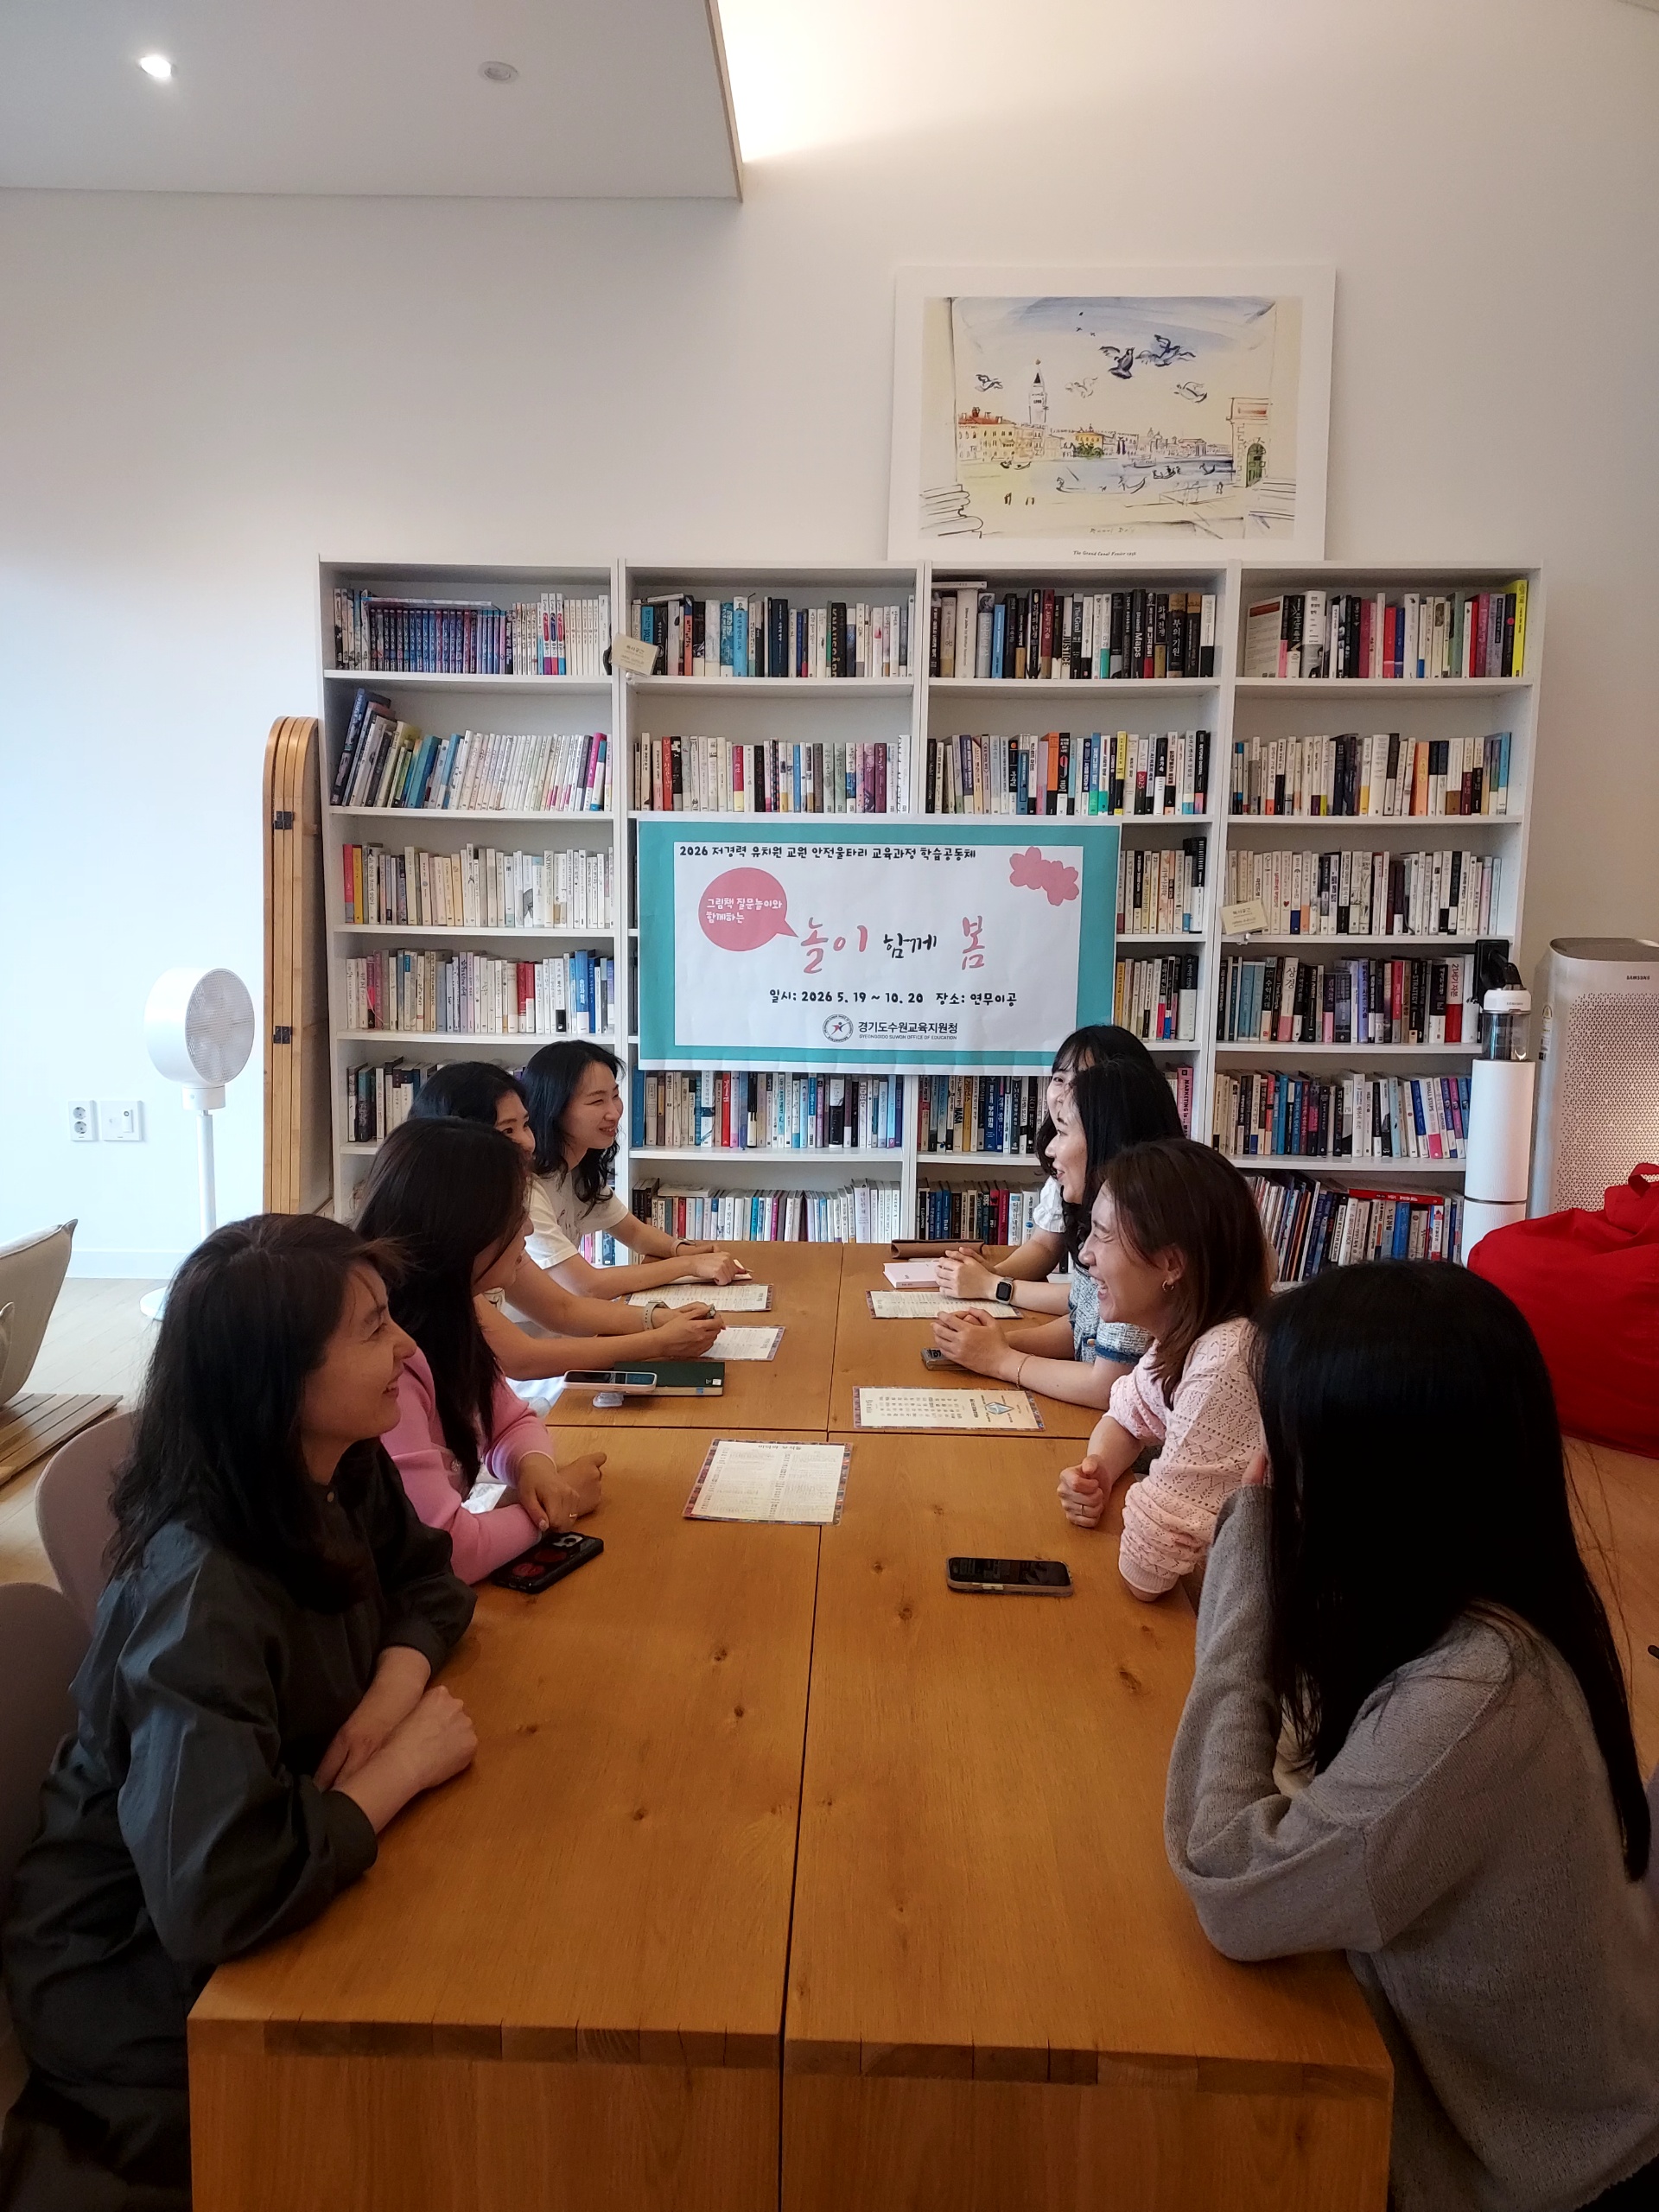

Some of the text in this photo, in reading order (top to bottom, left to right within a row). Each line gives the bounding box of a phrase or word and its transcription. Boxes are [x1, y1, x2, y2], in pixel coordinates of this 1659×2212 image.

[1134, 632, 1143, 658] Maps
[1172, 619, 1182, 657] 부의 기원
[1062, 635, 1071, 666] JUSTICE
[1137, 773, 1146, 790] 2025
[679, 845, 976, 861] 2026 저경력 유치원 교원 안전울타리 교육과정 학습공동체
[706, 897, 783, 911] 그림책 질문놀이와
[705, 911, 745, 924] 함께하는
[800, 914, 986, 974] 놀이 함께 봄
[1286, 967, 1297, 989] 상경
[1451, 963, 1460, 998] 21세기 자본
[769, 989, 797, 1003] 일시:
[801, 991, 833, 1002] 2026
[837, 992, 849, 1003] 5.
[853, 992, 867, 1002] 19
[885, 993, 903, 1004] 10.
[907, 993, 924, 1003] 20
[936, 992, 965, 1005] 장소:
[969, 993, 1017, 1007] 연무이공
[858, 1021, 958, 1034] 경기도수원교육지원청
[954, 1107, 963, 1124] NASA
